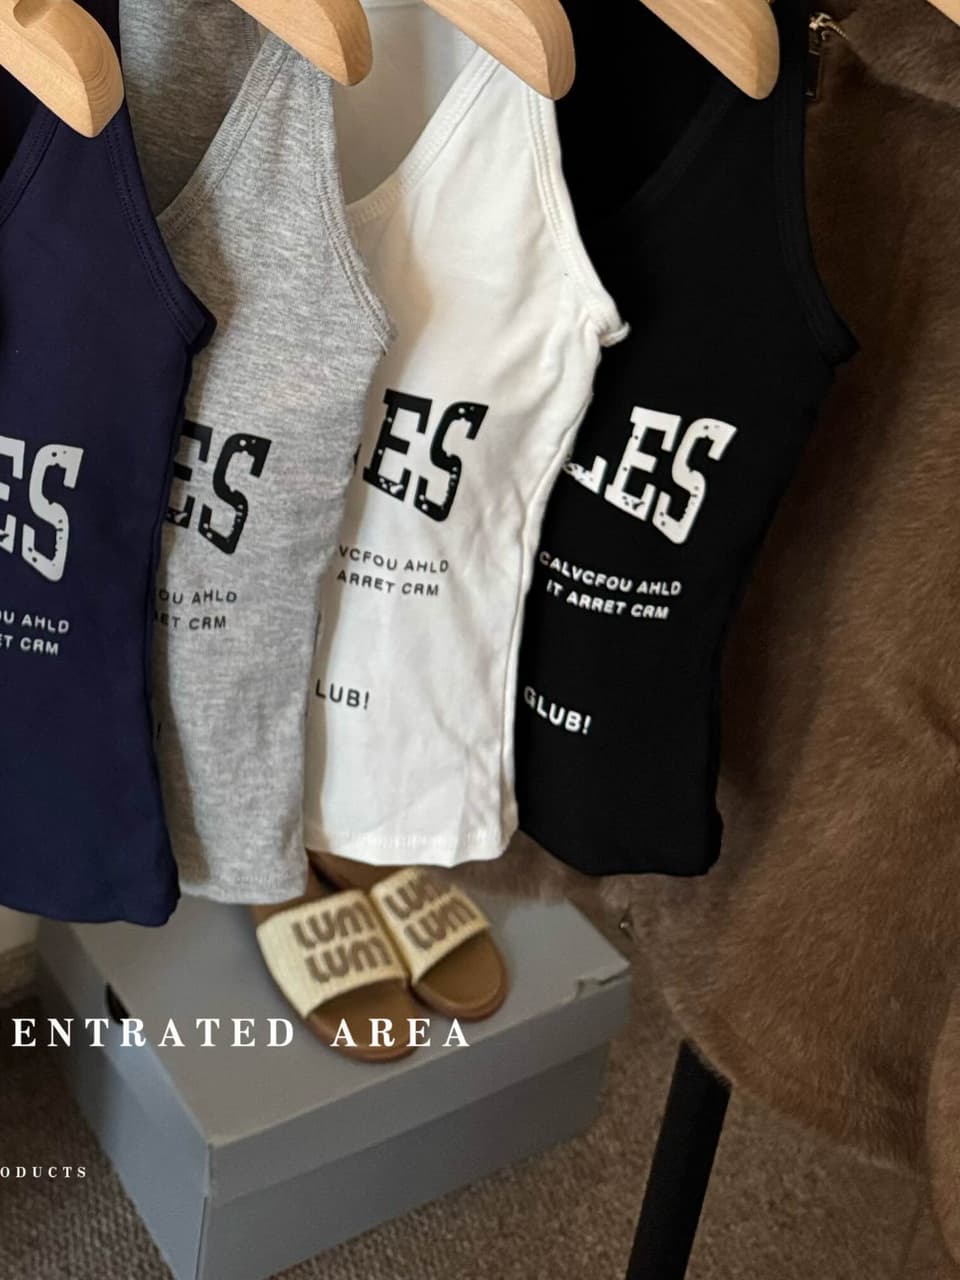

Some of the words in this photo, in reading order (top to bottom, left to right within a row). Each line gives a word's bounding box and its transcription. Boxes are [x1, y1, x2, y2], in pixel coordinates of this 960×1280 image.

[404, 558, 449, 574] AHLD
[337, 569, 396, 595] ARRET
[402, 582, 440, 597] CRM
[636, 580, 682, 596] AHLD
[191, 588, 238, 604] AHLD
[546, 579, 564, 597] IT
[566, 590, 628, 616] ARRET
[630, 602, 670, 620] CRM
[21, 613, 70, 634] AHLD
[188, 615, 227, 631] CRM
[20, 636, 60, 656] CRM
